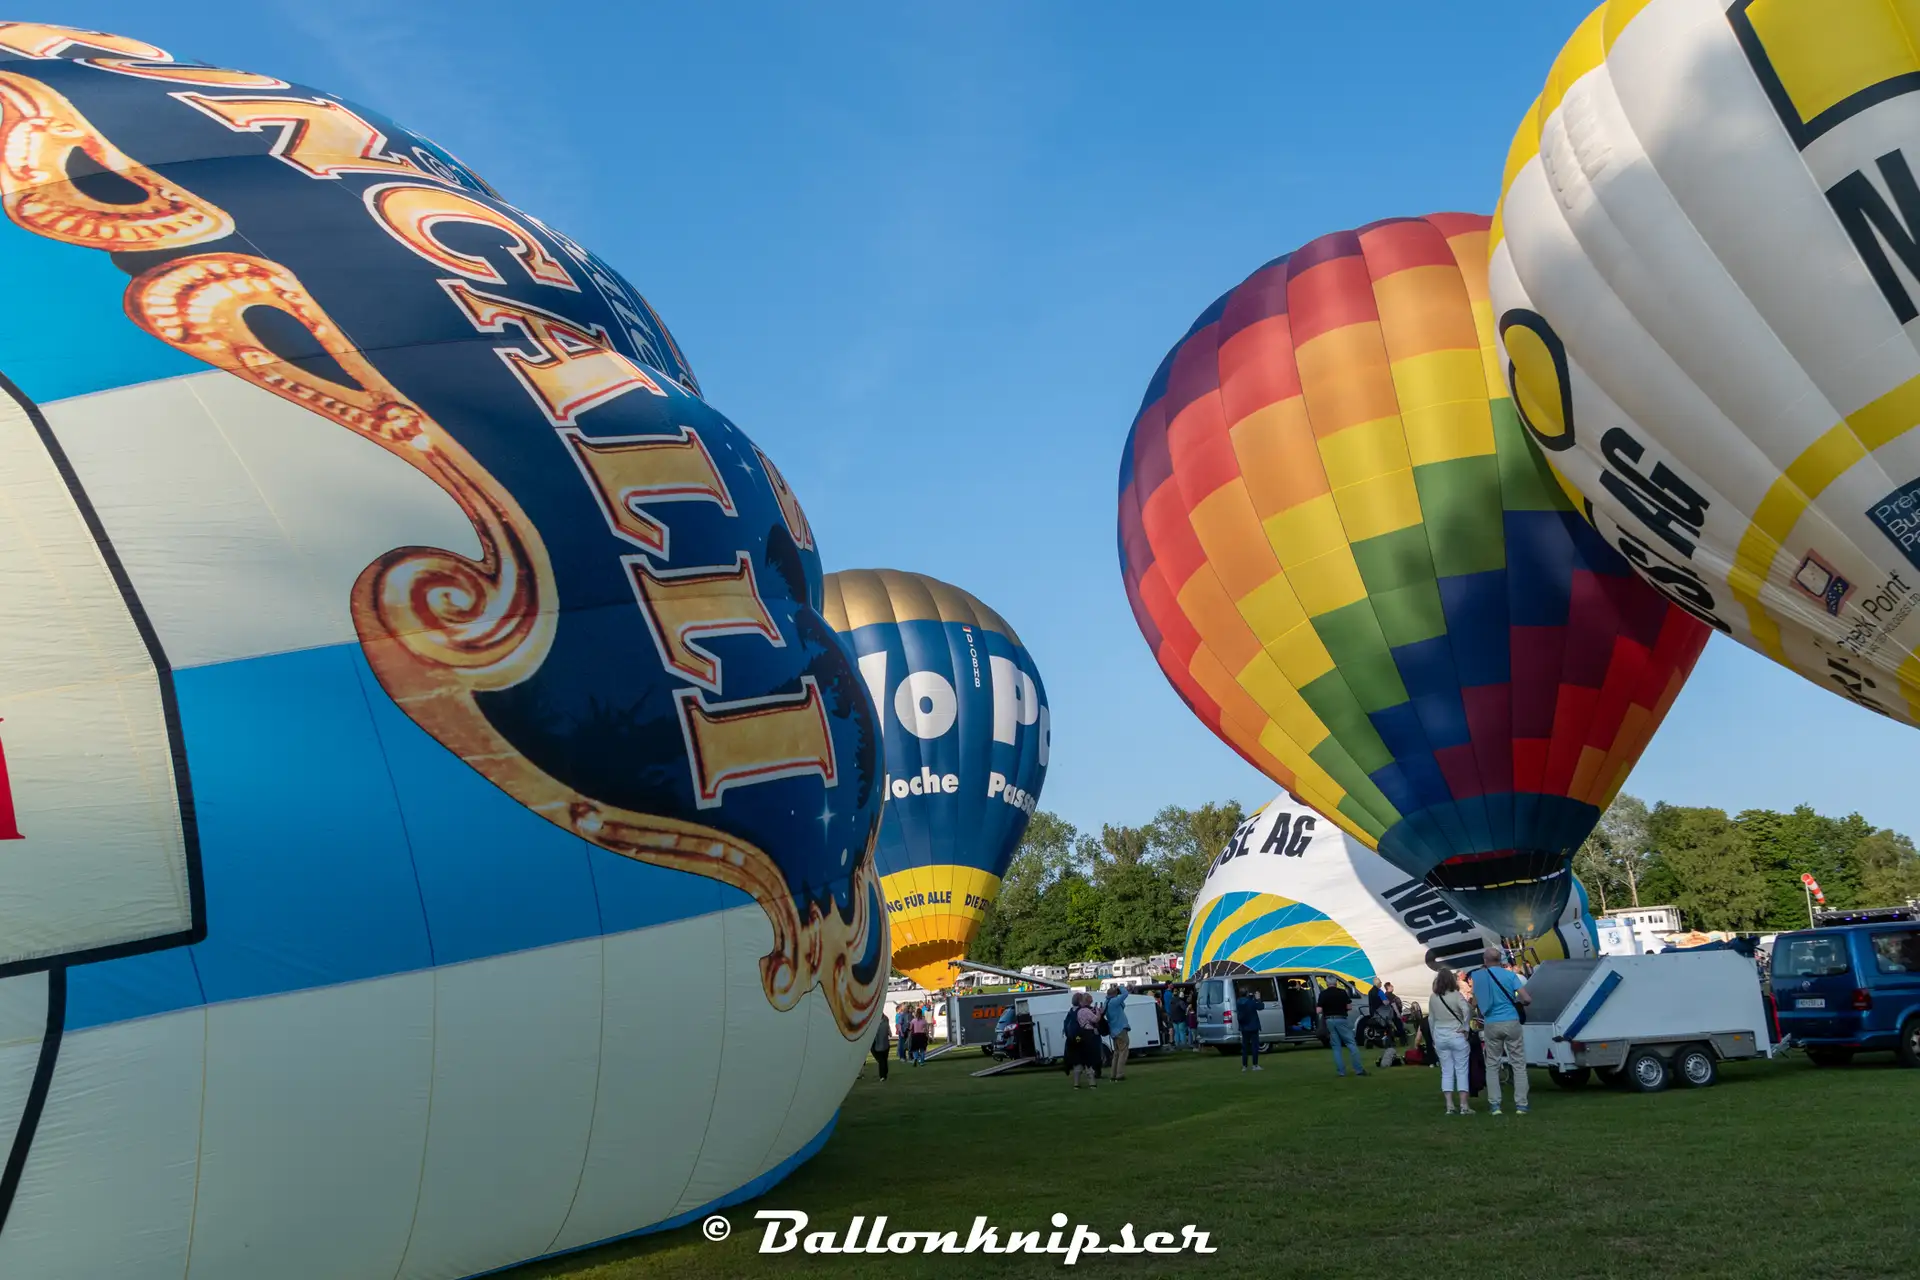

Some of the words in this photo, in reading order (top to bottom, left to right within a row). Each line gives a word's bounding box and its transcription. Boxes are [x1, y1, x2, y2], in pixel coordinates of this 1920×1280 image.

[1599, 426, 1710, 560] AG
[1862, 571, 1911, 621] Point
[885, 767, 959, 801] oche
[1260, 812, 1317, 858] AG
[904, 891, 925, 909] FÜR
[928, 891, 952, 904] ALLE
[965, 893, 980, 908] DIE
